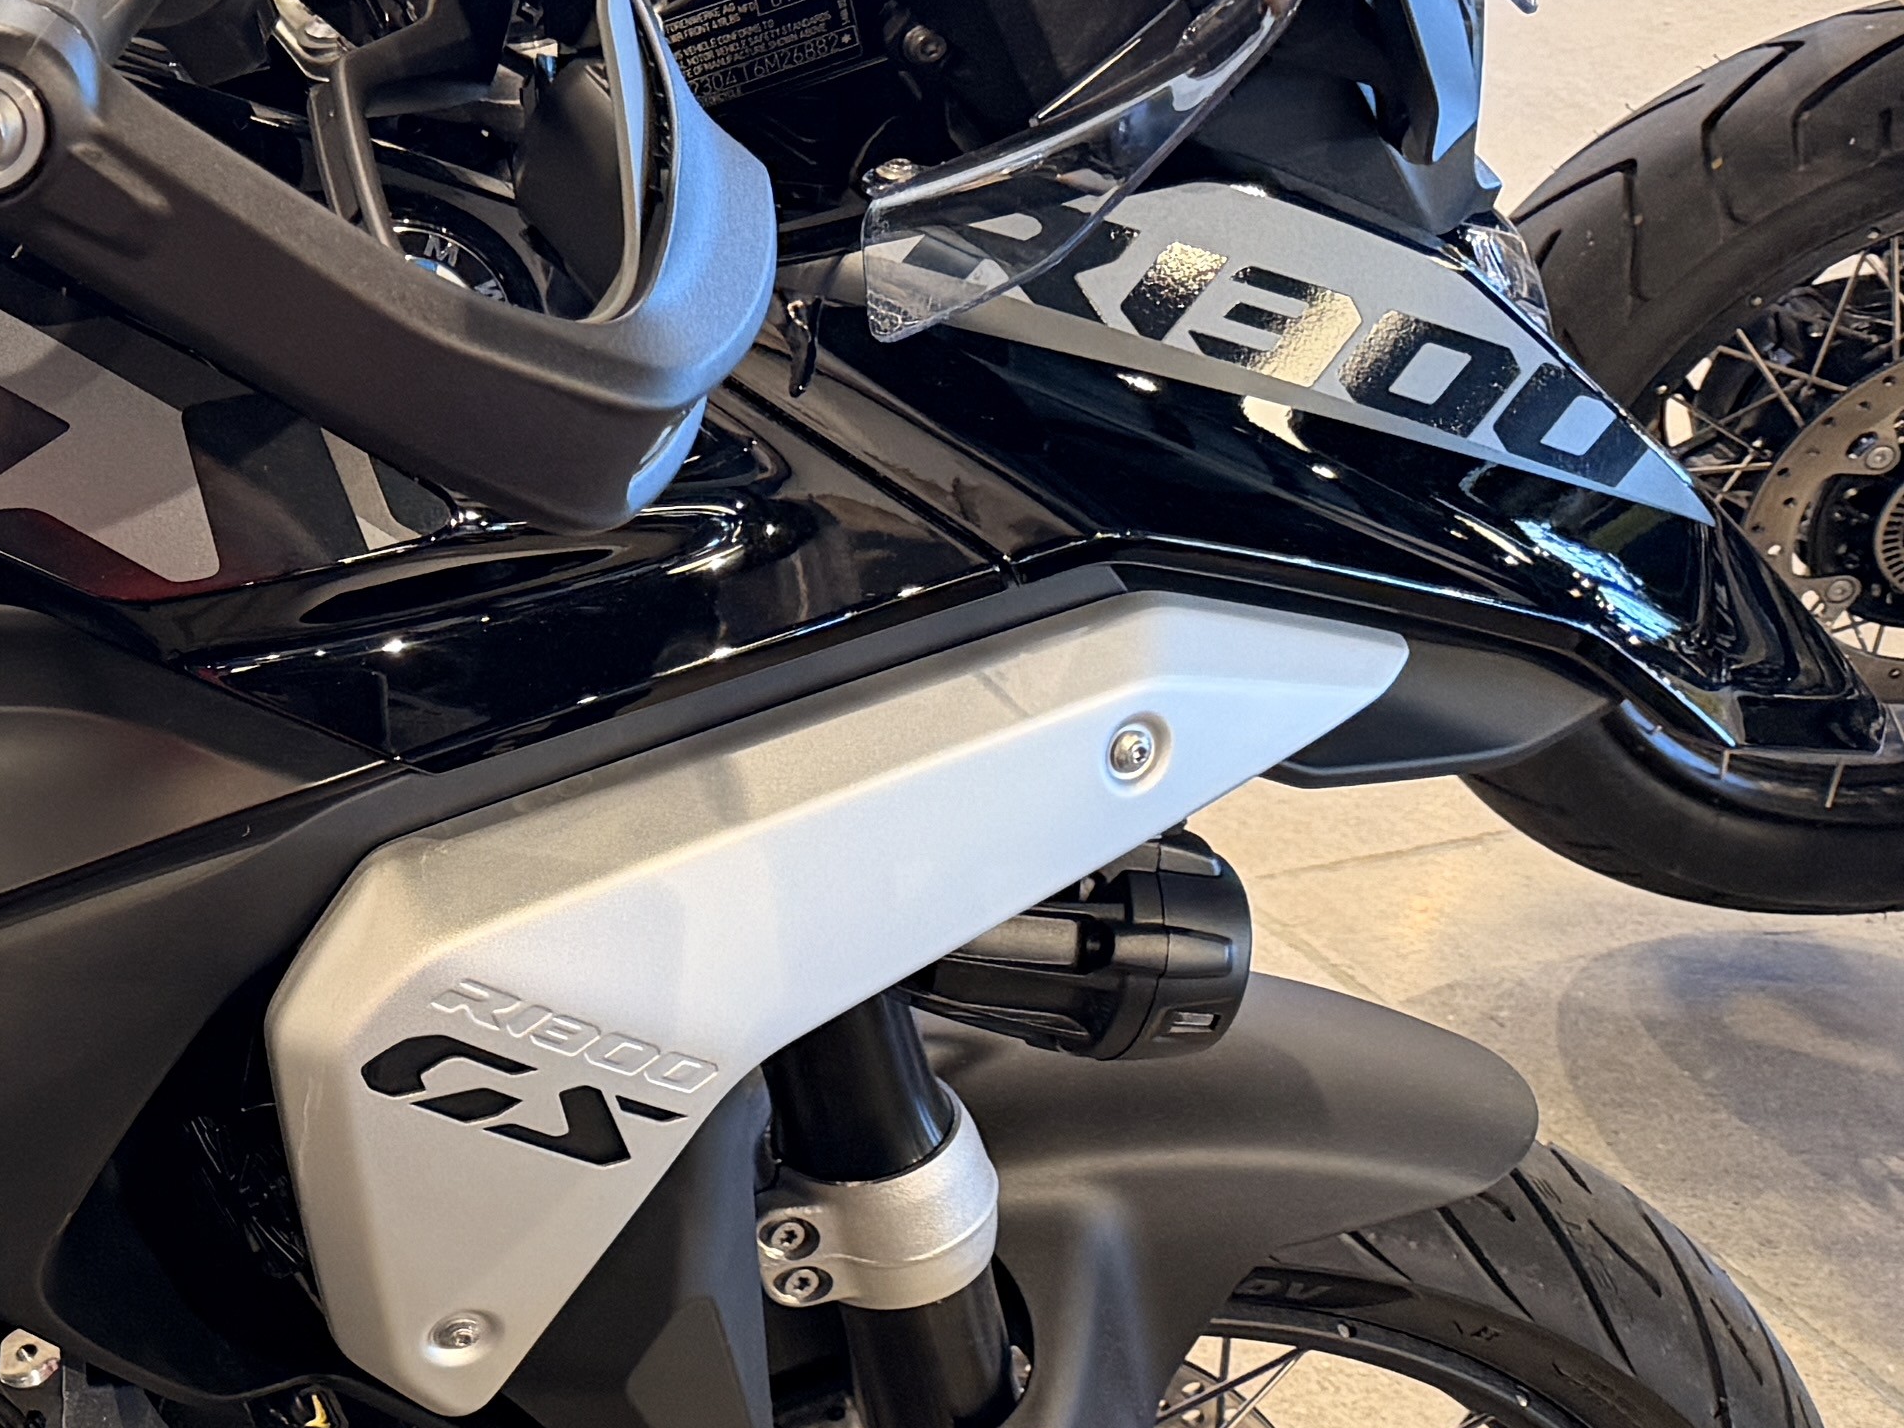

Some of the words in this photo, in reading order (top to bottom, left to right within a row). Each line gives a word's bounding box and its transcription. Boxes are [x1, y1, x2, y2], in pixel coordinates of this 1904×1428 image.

[762, 19, 774, 30] TO
[430, 977, 719, 1094] R1300
[360, 1033, 690, 1167] GS
